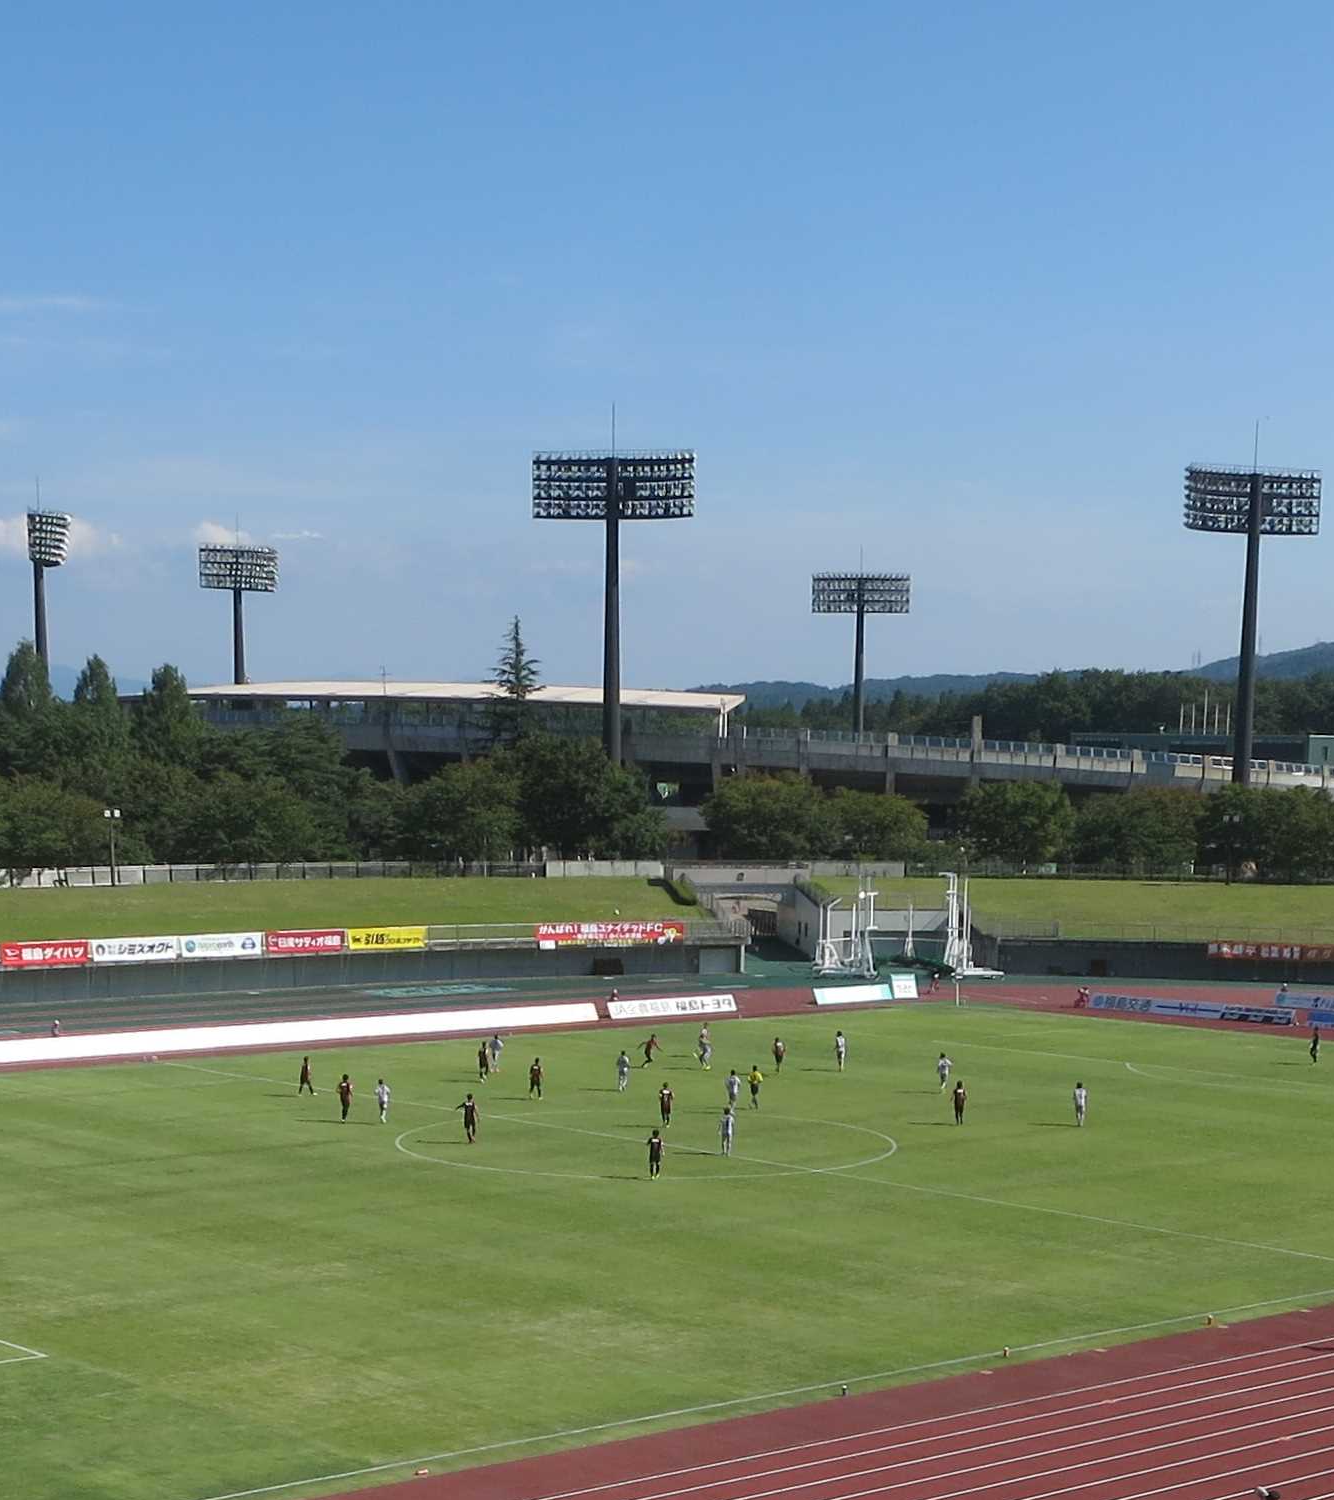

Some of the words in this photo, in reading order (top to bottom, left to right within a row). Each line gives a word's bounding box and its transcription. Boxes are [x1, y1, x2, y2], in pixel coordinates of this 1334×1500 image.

[21, 945, 84, 961] 福島ダイハツ
[676, 998, 733, 1012] 福島トヨタ
